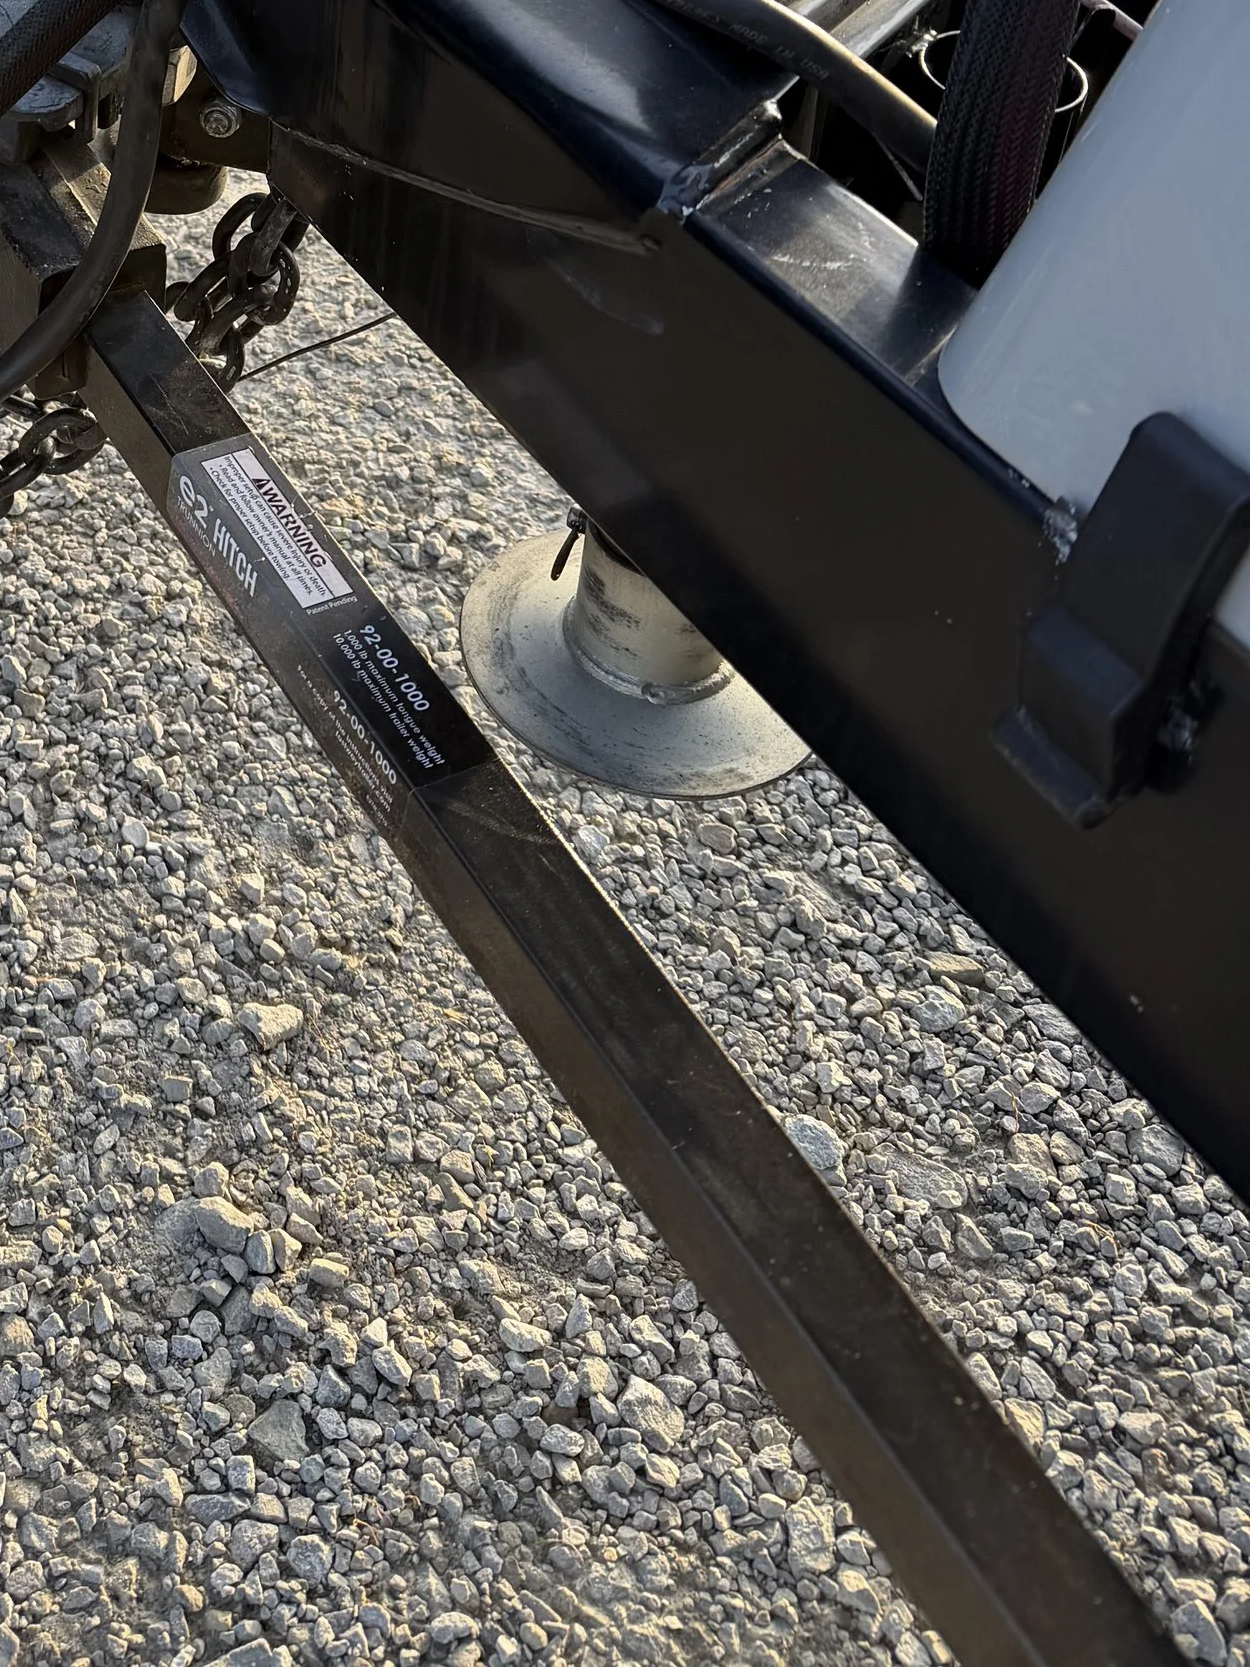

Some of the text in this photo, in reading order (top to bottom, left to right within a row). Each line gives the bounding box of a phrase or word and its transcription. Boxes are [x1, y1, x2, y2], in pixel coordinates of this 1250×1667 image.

[209, 469, 229, 488] Check
[218, 466, 236, 483] Read
[223, 487, 236, 497] for
[229, 482, 244, 495] and
[220, 455, 249, 483] Improper
[253, 500, 267, 512] can
[261, 511, 280, 529] cause
[274, 529, 295, 550] severe
[287, 549, 308, 568] injury
[302, 568, 312, 576] or
[227, 497, 249, 518] proper
[238, 494, 258, 513] follow
[176, 495, 217, 557] TRUNNION
[242, 517, 262, 537] setup
[255, 486, 333, 568] WARNING
[256, 535, 277, 556] before
[267, 536, 292, 560] manual
[213, 518, 258, 598] HITCH
[285, 559, 296, 568] at
[290, 566, 302, 576] all
[306, 592, 358, 616] Patent Pending
[349, 659, 363, 670] lb
[356, 649, 370, 660] lb
[354, 623, 435, 712] 92-00-1000
[354, 669, 395, 713] maximum
[362, 659, 401, 703] maximum
[386, 711, 413, 738] trailer
[392, 701, 424, 734] tongue
[333, 689, 398, 786] 92-00-1000
[414, 733, 447, 766] weight
[402, 737, 435, 770] weight
